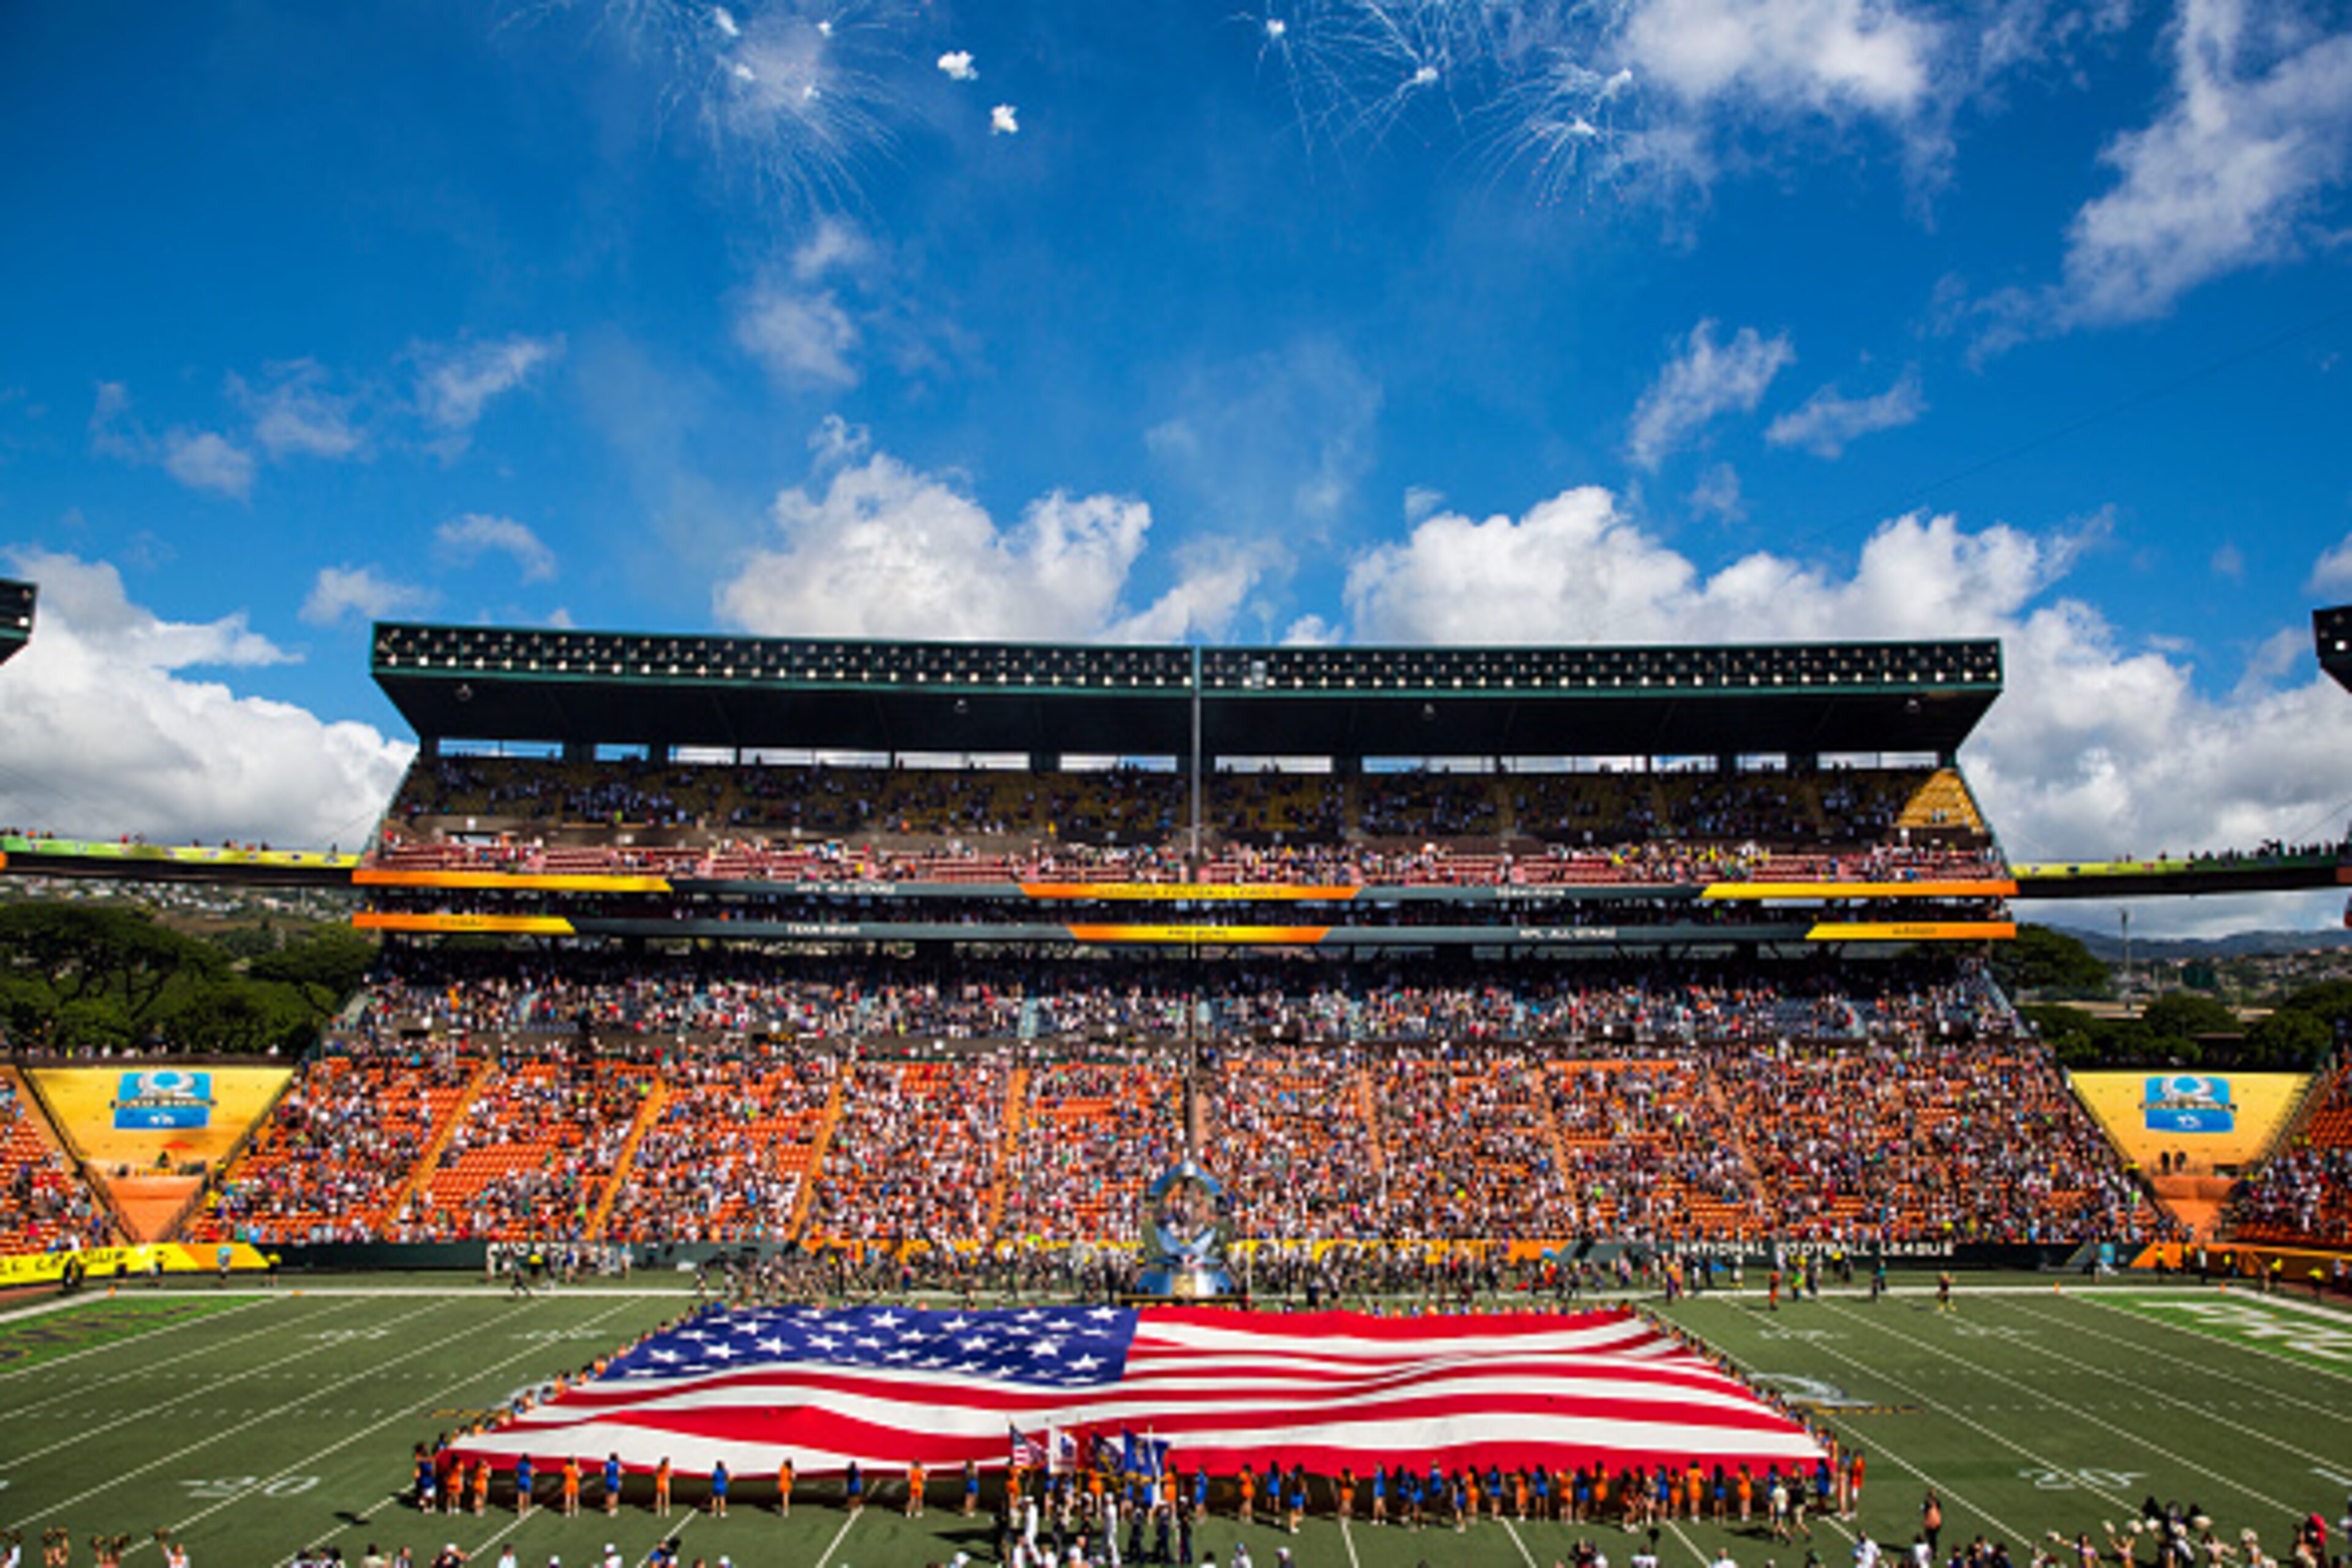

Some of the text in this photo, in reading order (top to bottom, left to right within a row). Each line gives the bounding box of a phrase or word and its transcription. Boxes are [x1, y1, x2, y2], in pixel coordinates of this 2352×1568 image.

[1675, 1242, 1953, 1256] NATIONAL FOOTBALL LEAGUE
